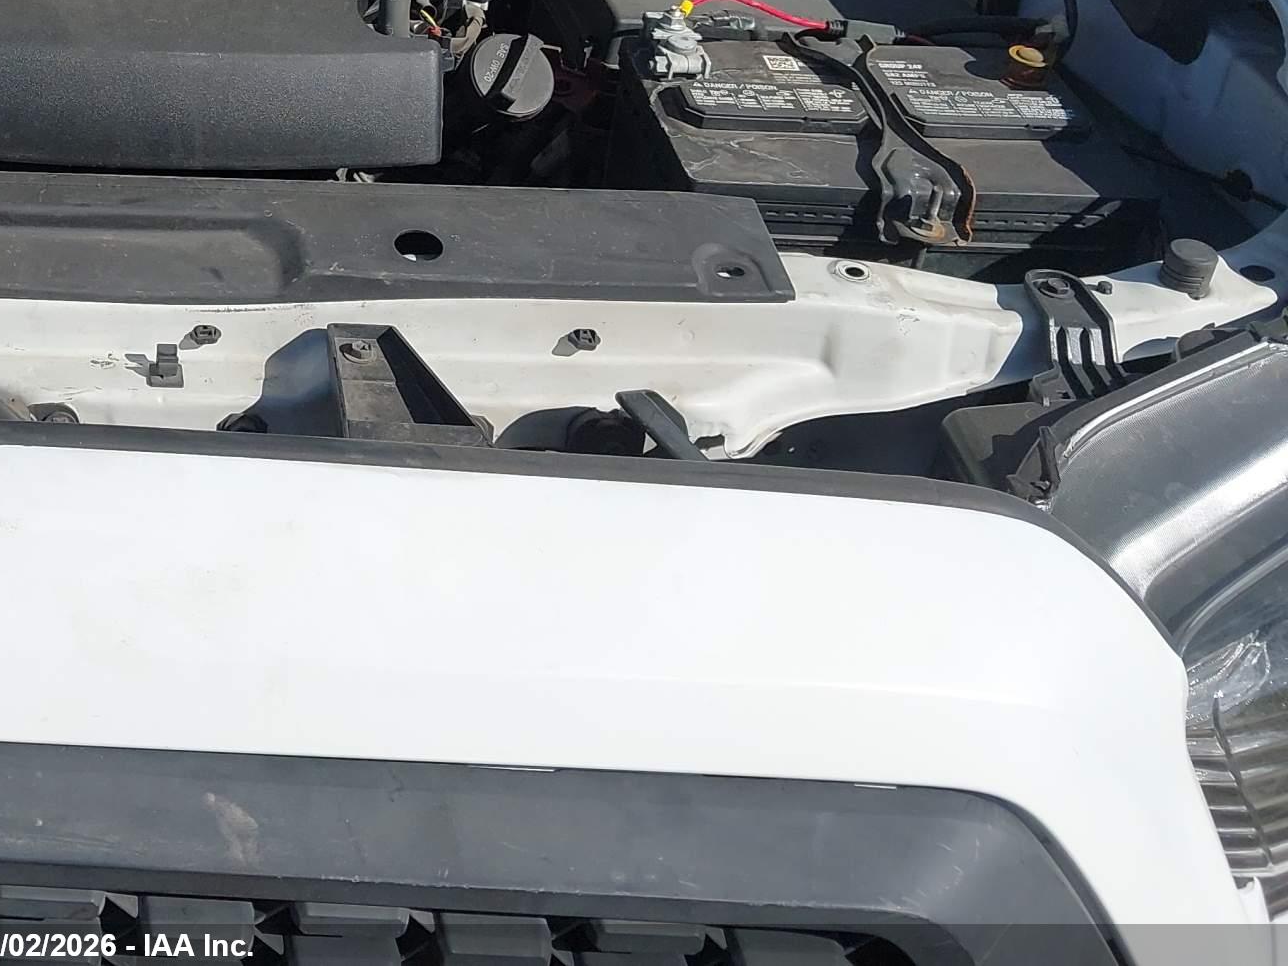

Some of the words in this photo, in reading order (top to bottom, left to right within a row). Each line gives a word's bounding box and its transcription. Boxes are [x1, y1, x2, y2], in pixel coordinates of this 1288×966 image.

[496, 43, 509, 59] SAE
[704, 81, 737, 90] DANGER
[745, 83, 778, 91] POISON
